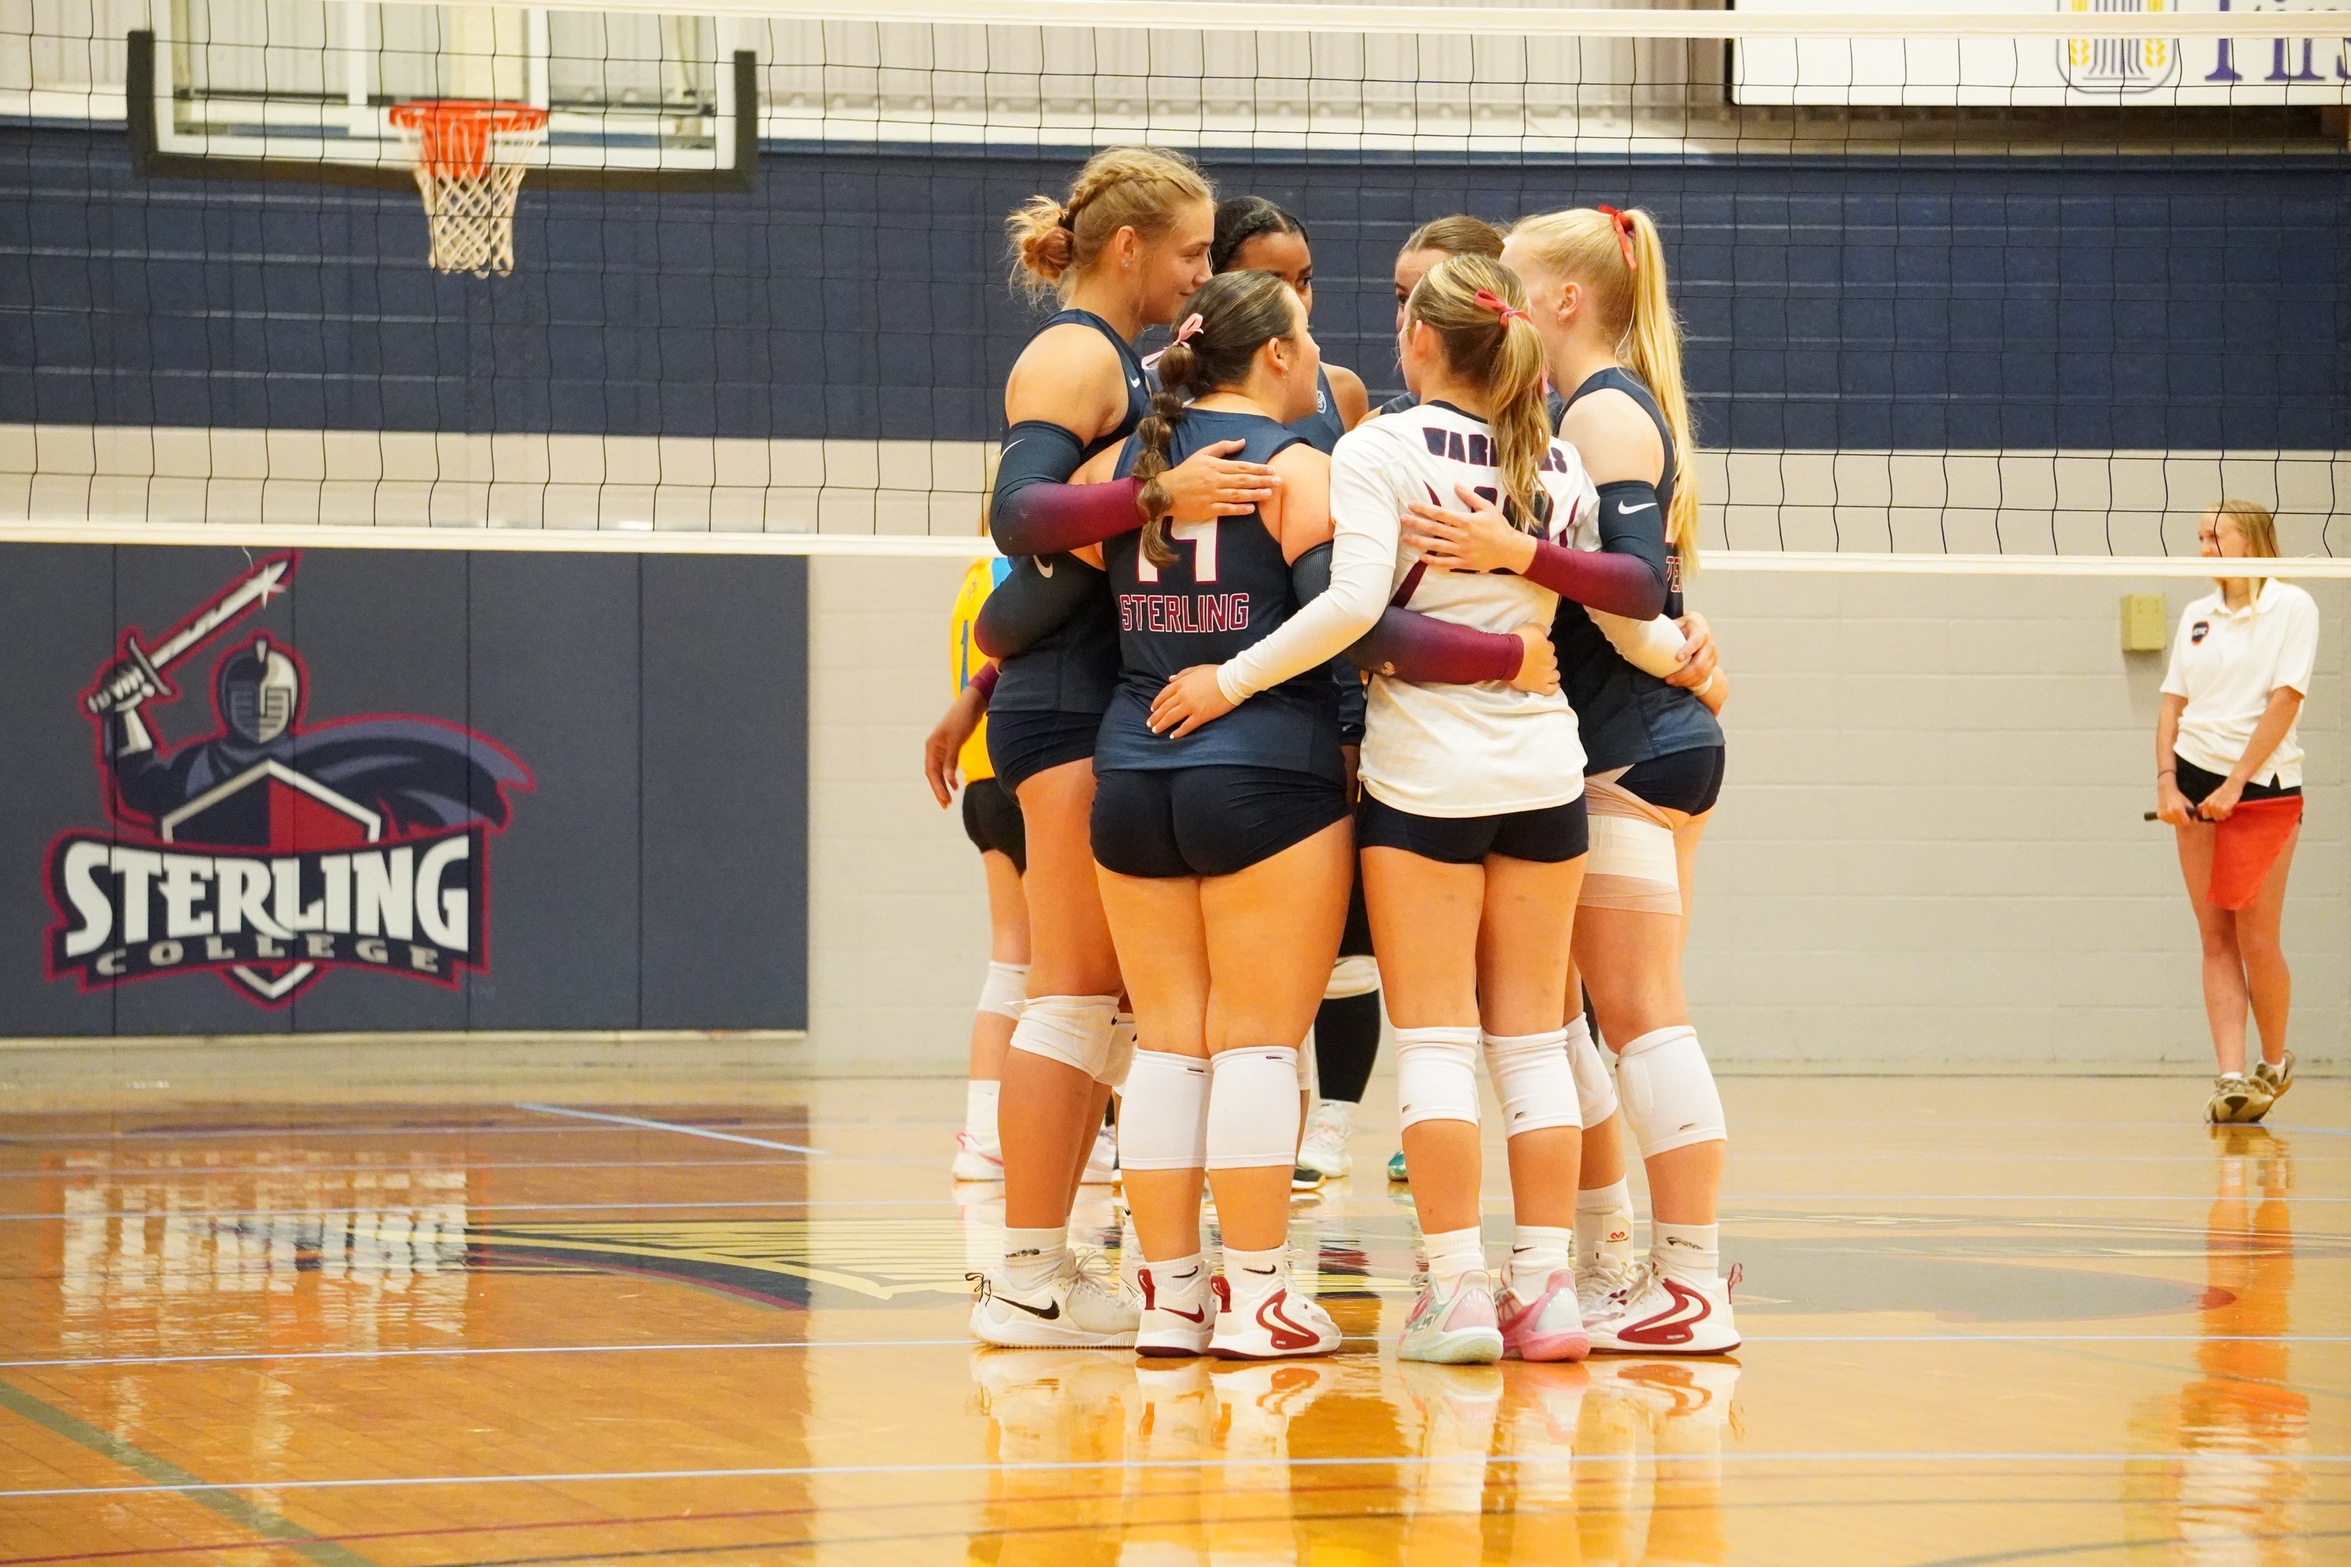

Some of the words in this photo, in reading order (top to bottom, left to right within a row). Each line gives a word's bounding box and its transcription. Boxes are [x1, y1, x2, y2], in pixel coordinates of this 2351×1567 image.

[1119, 592, 1249, 633] STERLING
[64, 834, 470, 957] STERLING
[96, 934, 439, 976] COLLEGE
